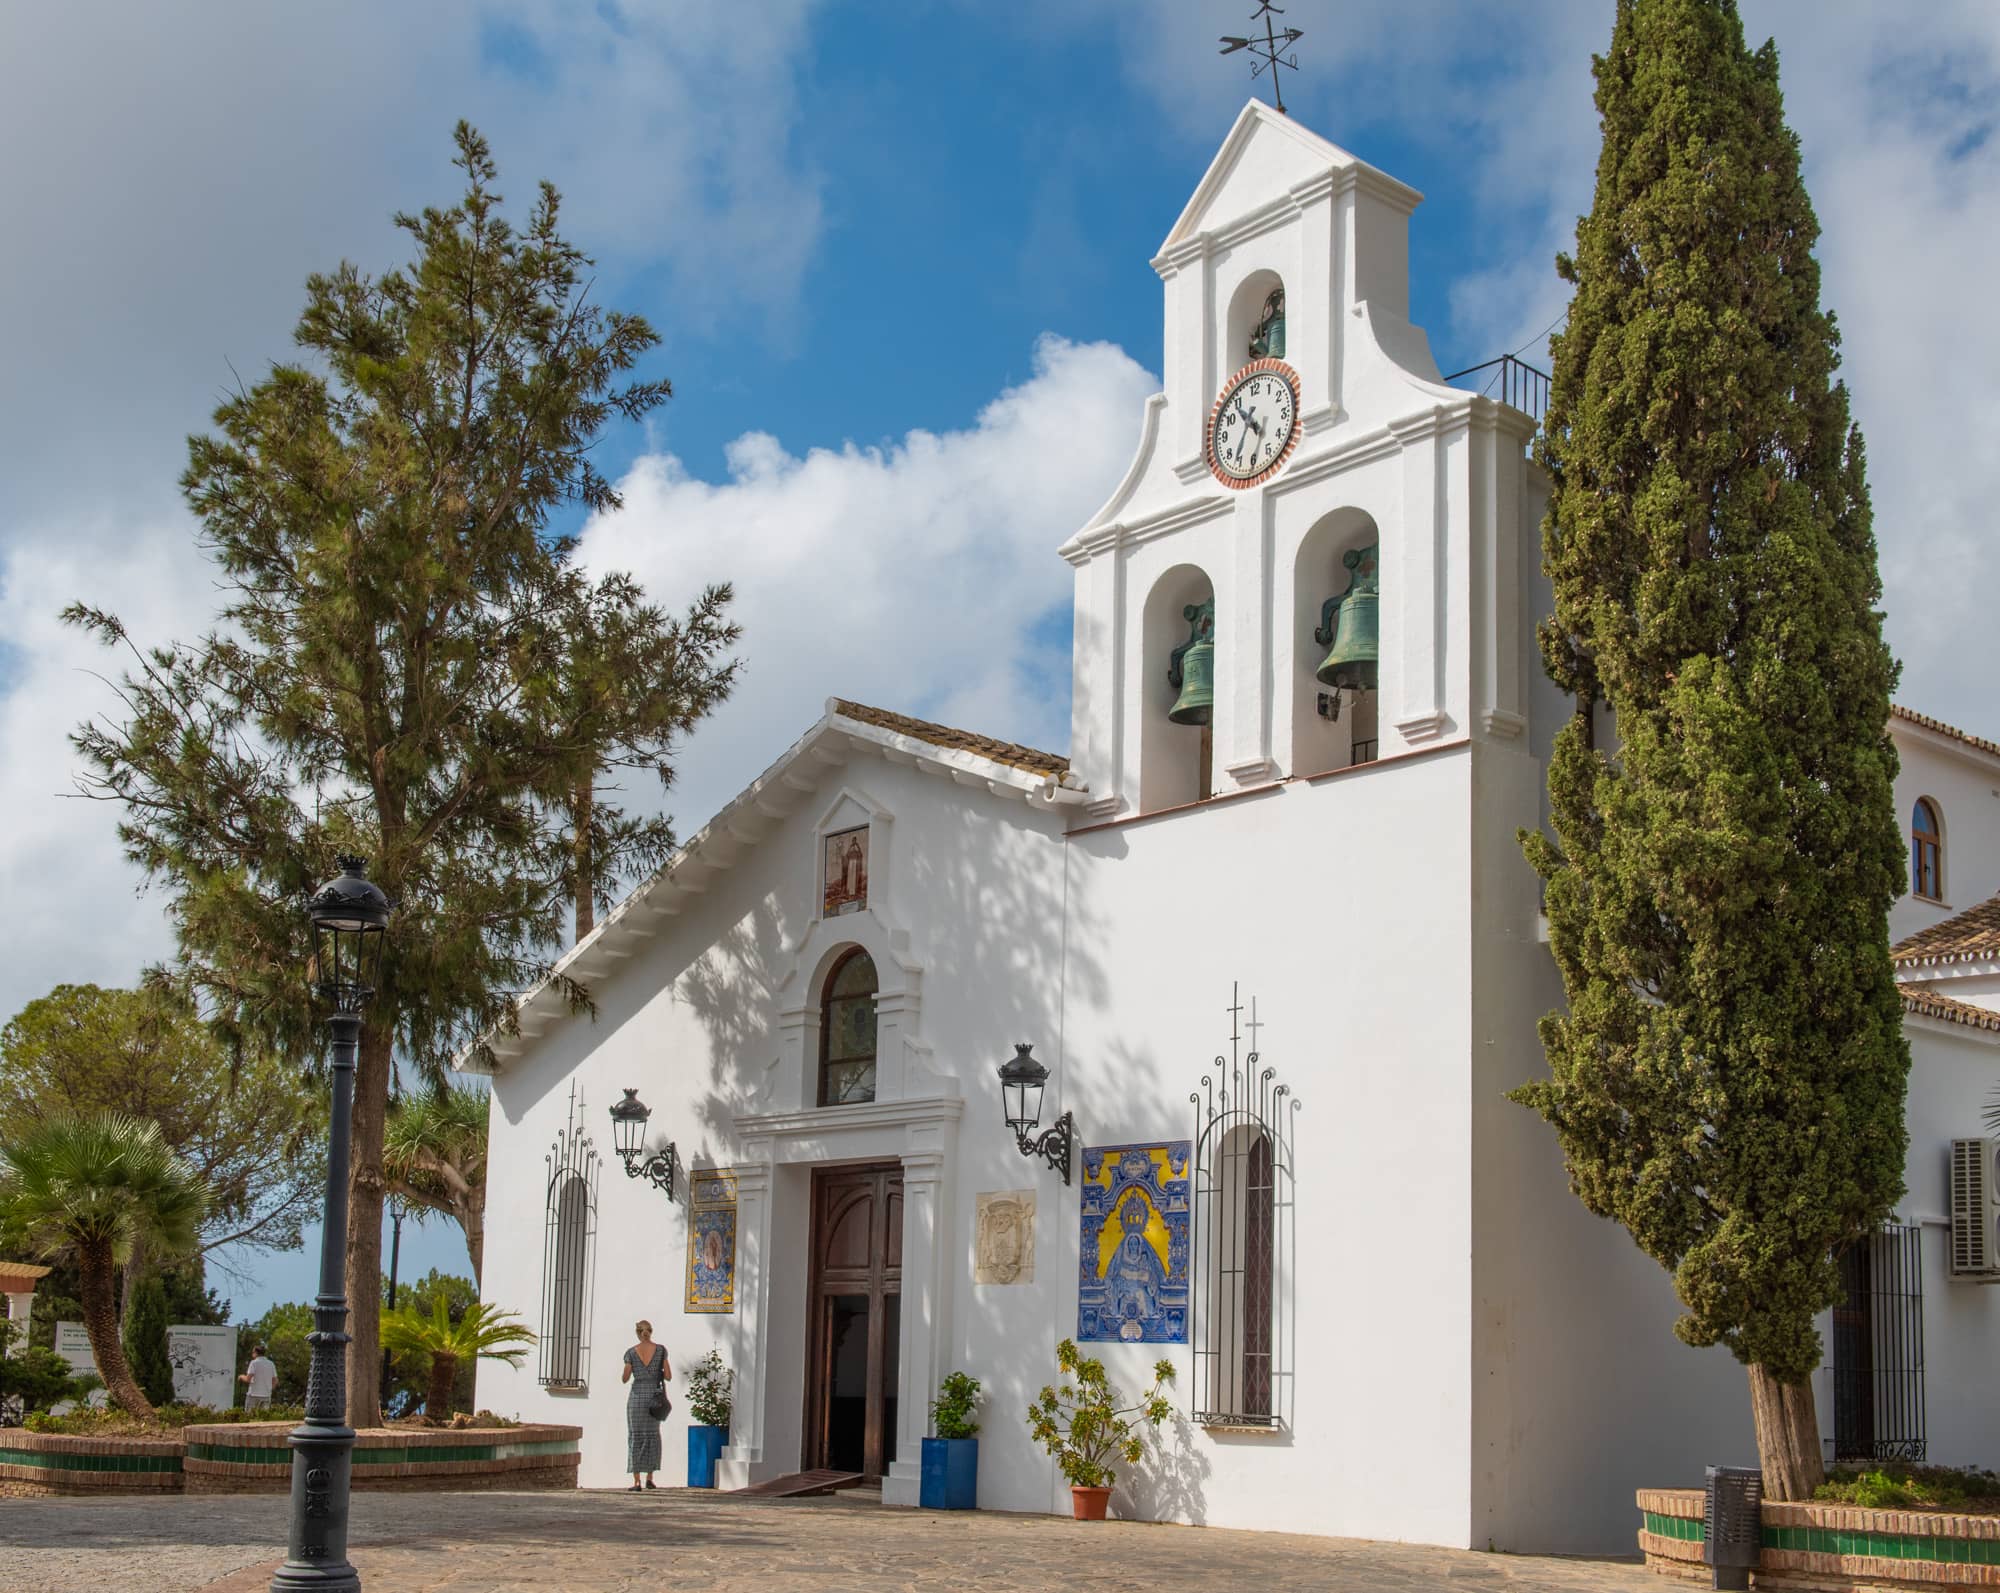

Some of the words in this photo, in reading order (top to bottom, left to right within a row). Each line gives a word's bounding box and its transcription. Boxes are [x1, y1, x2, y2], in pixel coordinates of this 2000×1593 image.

[1250, 382, 1260, 396] 12
[1267, 384, 1271, 395] 1
[1235, 396, 1242, 409] 11
[1276, 390, 1282, 403] 2
[1281, 407, 1287, 419] 3
[1226, 413, 1236, 427] 10
[1222, 431, 1228, 443] 9
[1275, 427, 1281, 439] 4
[1226, 448, 1232, 460] 8
[1265, 442, 1272, 455] 5
[1237, 455, 1242, 467] 7
[1250, 454, 1256, 466] 6
